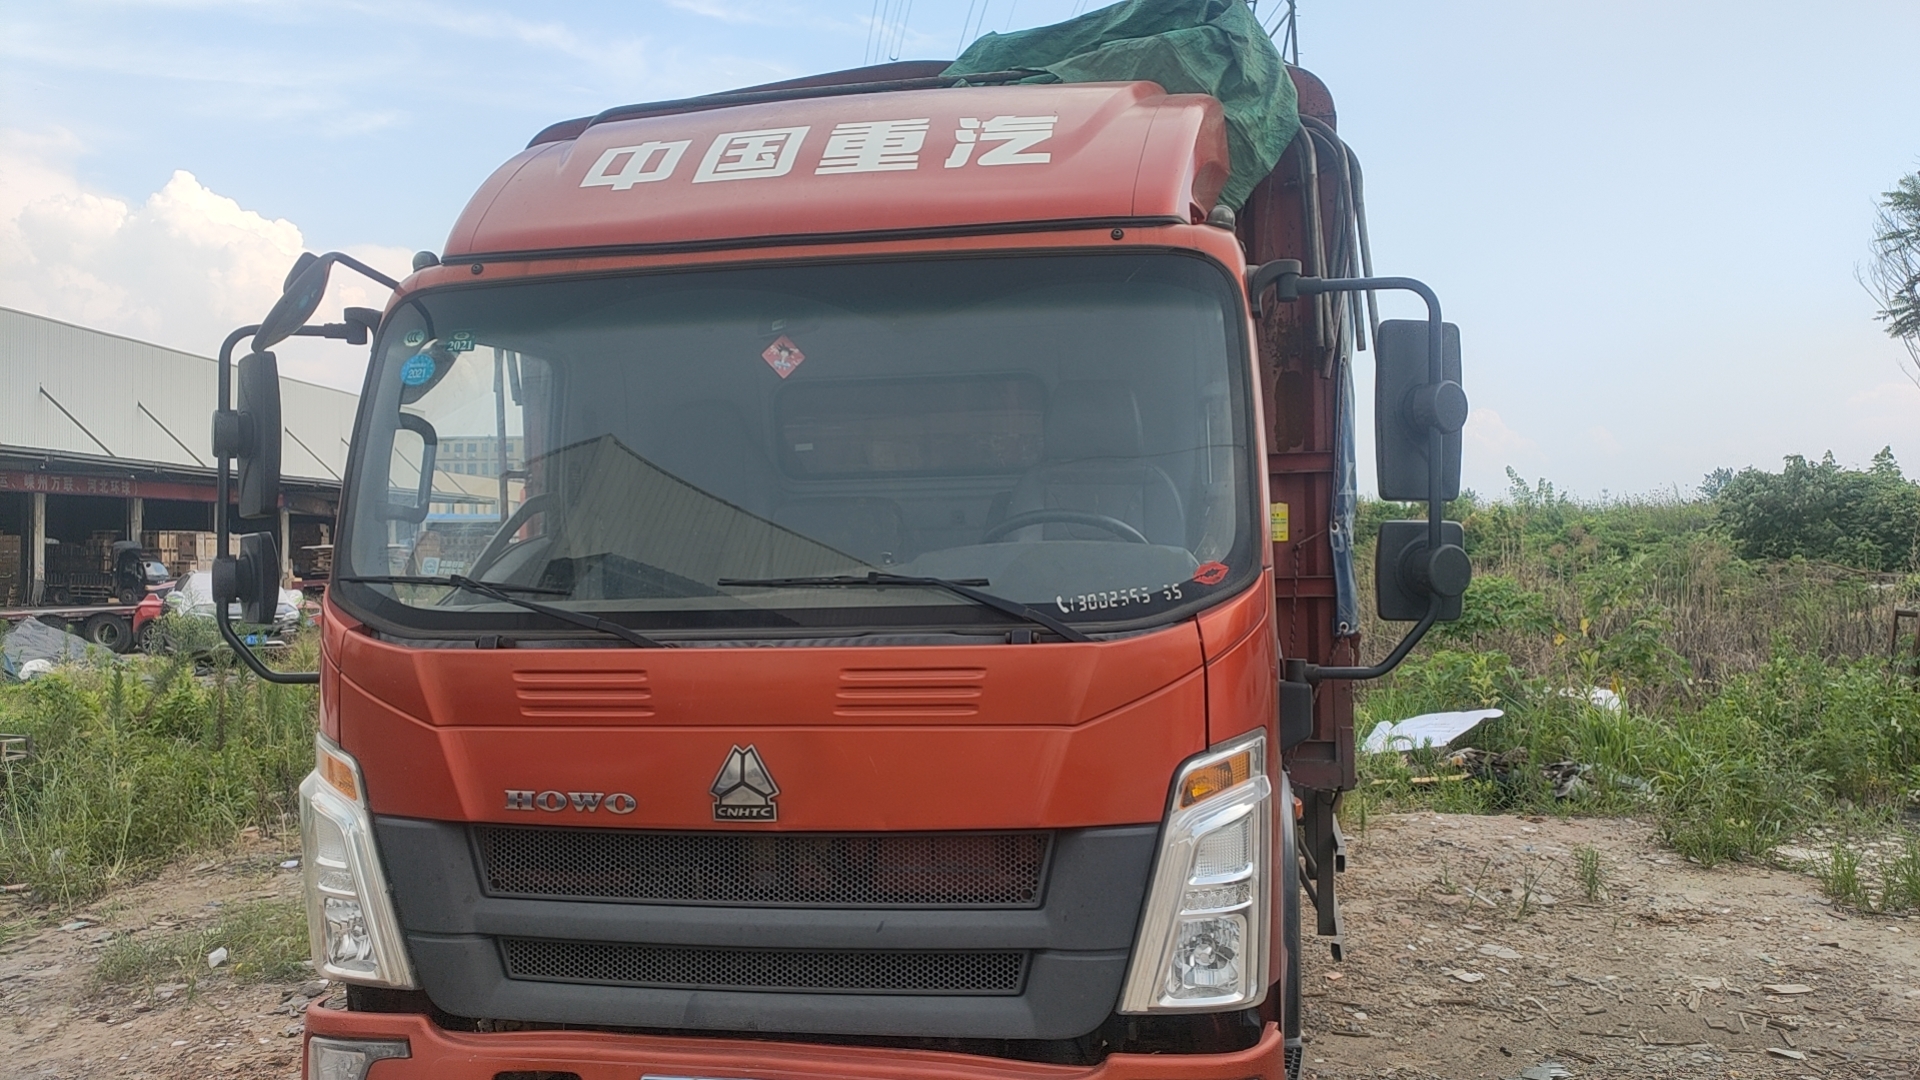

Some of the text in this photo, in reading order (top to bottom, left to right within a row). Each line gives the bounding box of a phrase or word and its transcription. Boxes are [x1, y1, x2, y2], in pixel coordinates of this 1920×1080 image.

[579, 115, 1058, 191] 中国重汽
[447, 340, 472, 351] 2021
[407, 368, 426, 379] 2021
[504, 789, 637, 814] HOWO
[717, 807, 771, 817] CNHTC
